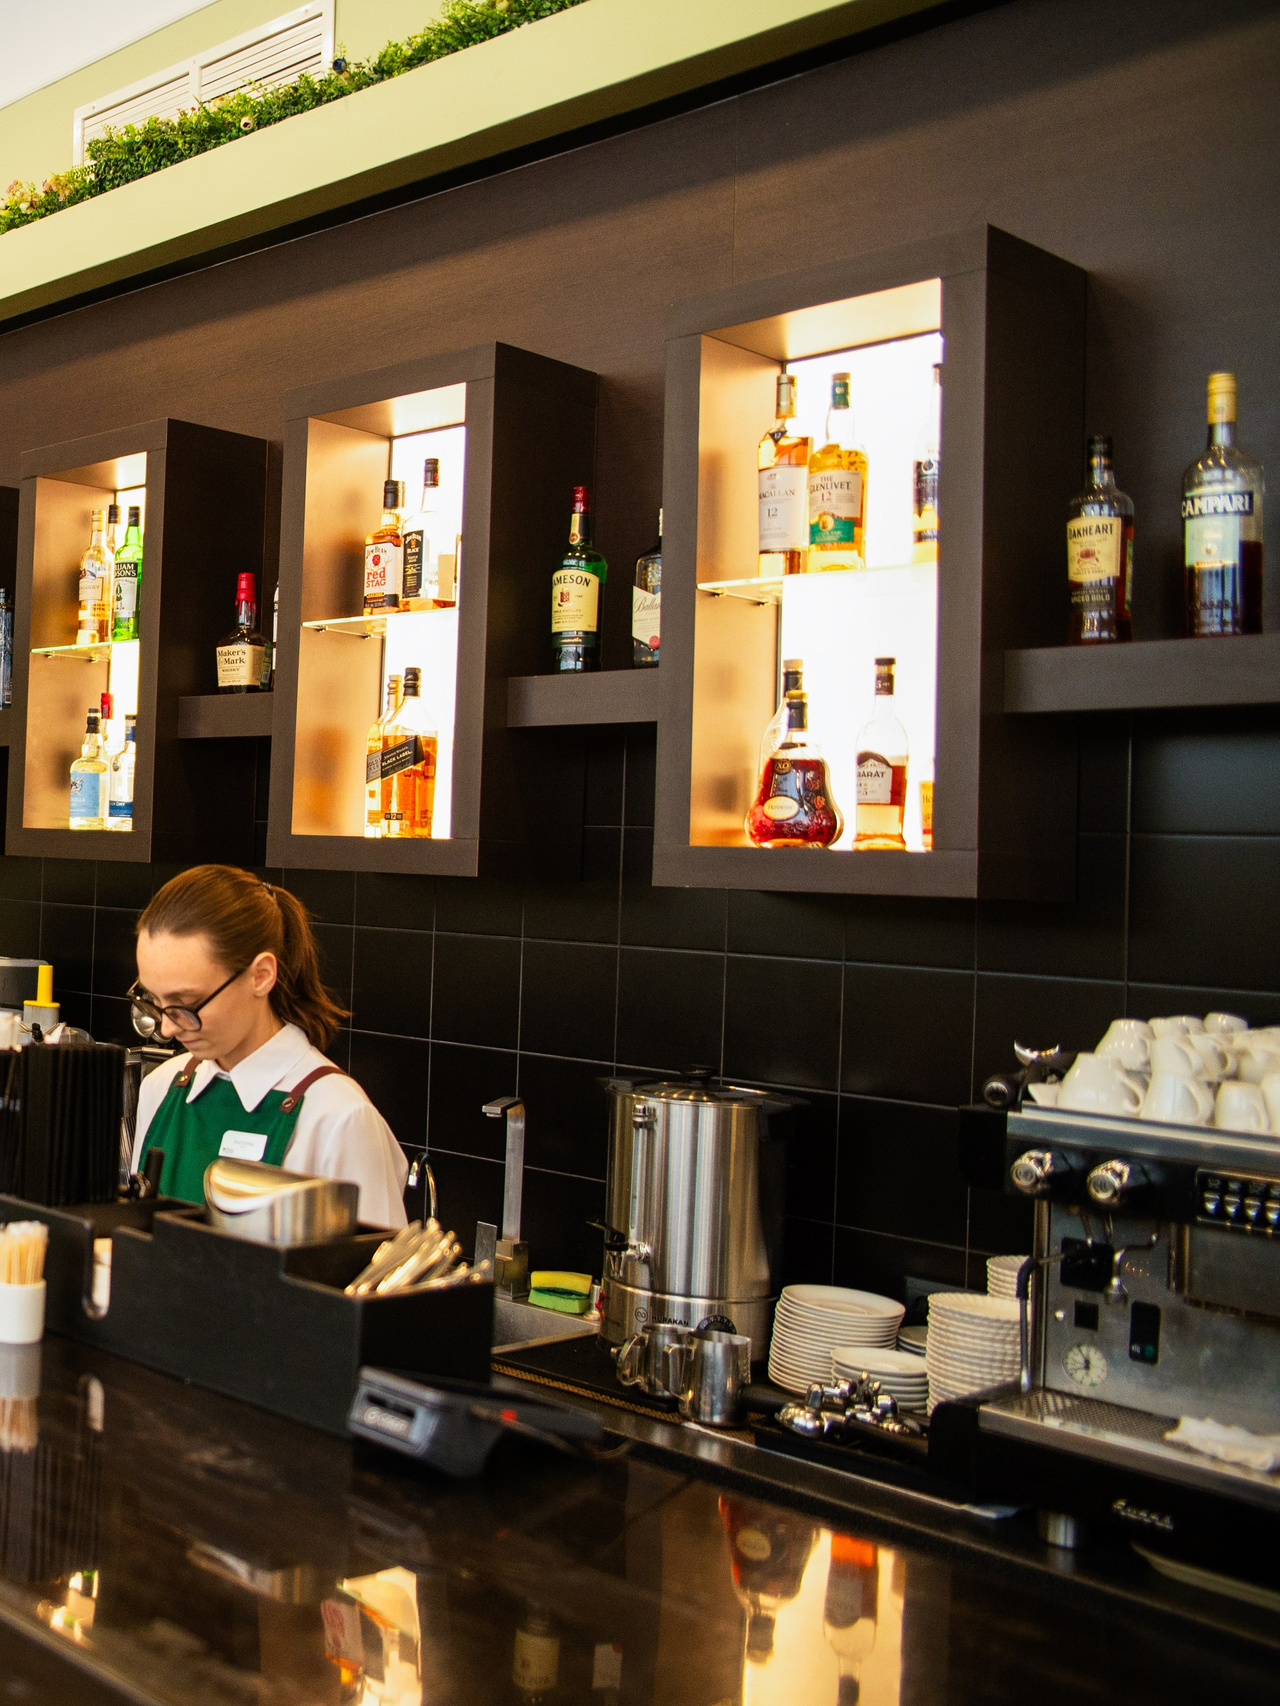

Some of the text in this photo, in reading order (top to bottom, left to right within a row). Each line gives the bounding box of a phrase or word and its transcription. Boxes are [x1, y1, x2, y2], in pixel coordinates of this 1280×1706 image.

[809, 481, 851, 494] GLENLIVET
[821, 491, 832, 501] 12
[1181, 494, 1250, 518] CAMPARI
[767, 507, 778, 517] 12
[1069, 523, 1114, 540] OAKHEART
[115, 563, 134, 571] LIAM
[115, 569, 136, 577] SON'S
[366, 567, 386, 580] red
[366, 578, 386, 588] STAG
[552, 574, 591, 588] AMESON
[217, 649, 246, 658] Maker's
[224, 657, 246, 665] Mark
[776, 762, 790, 771] XO
[856, 770, 886, 779] RARAT
